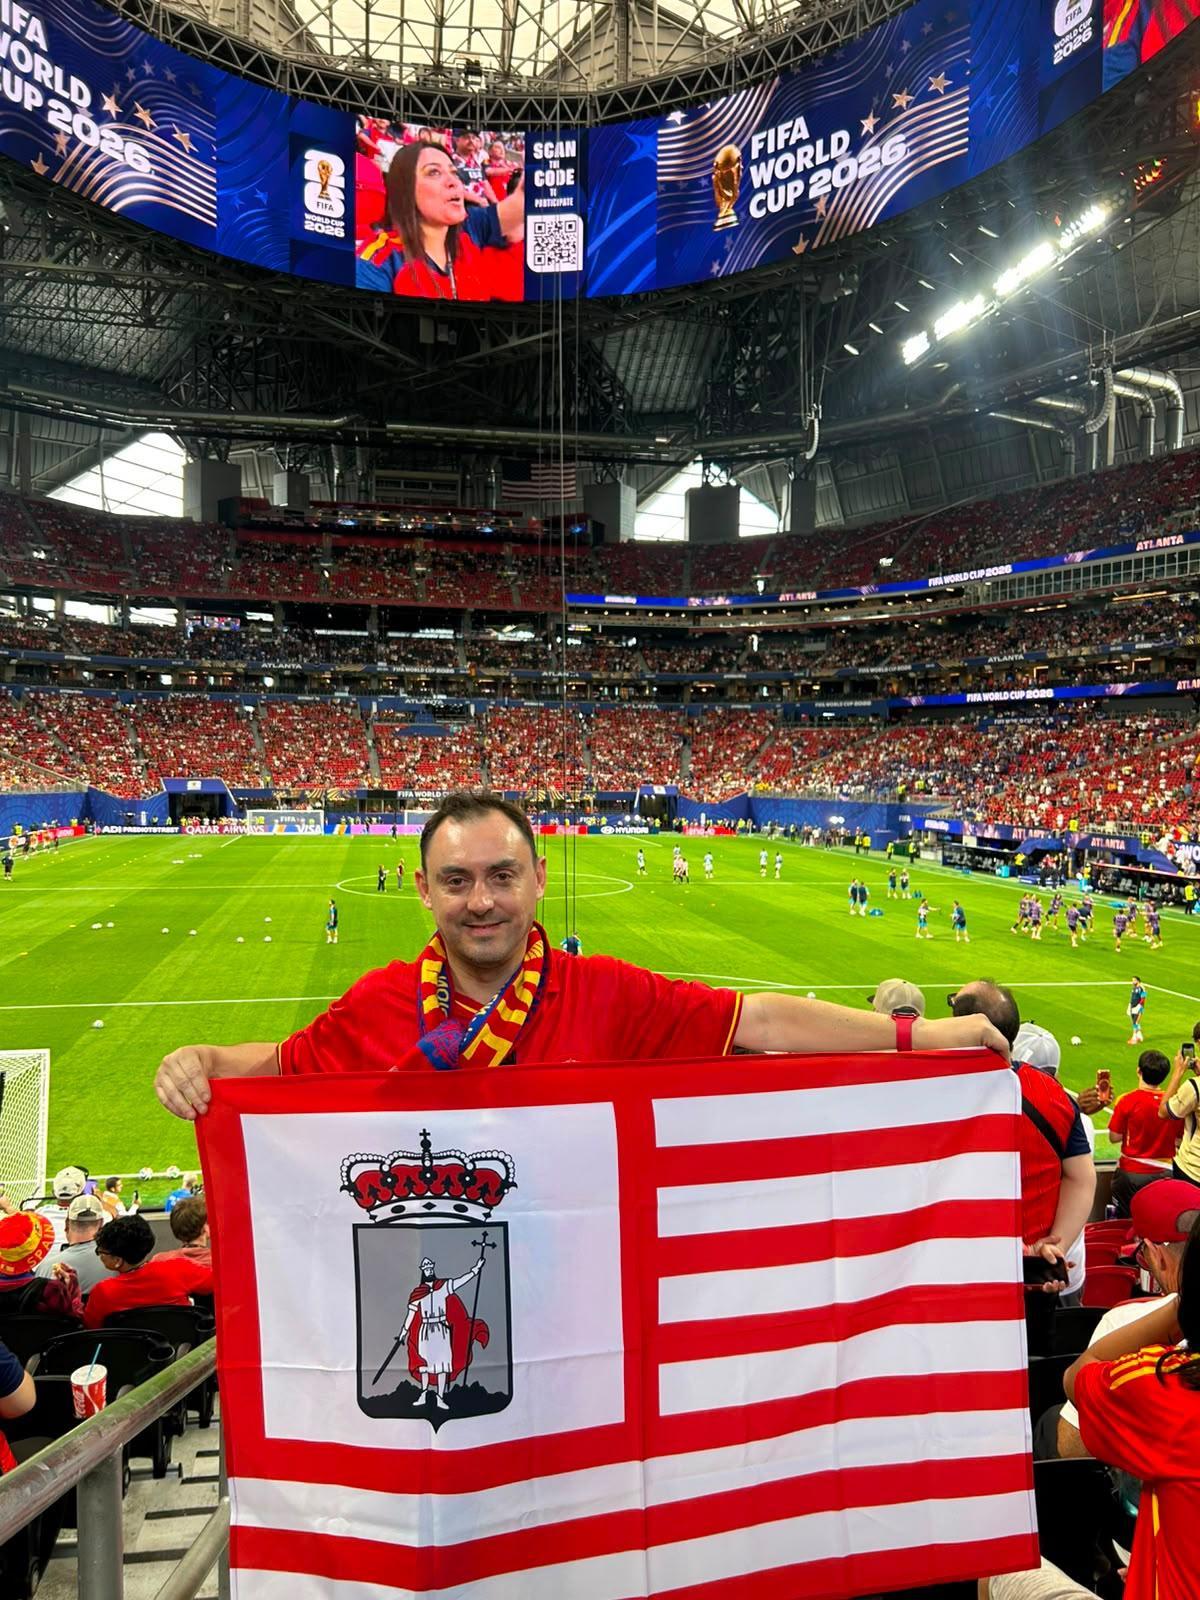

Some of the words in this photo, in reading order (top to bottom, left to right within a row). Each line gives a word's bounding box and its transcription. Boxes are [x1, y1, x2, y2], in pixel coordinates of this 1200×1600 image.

[1065, 6, 1082, 25] FIFA
[1054, 28, 1079, 50] WORLD
[1079, 17, 1092, 32] CUP
[1053, 27, 1092, 65] 2026
[0, 68, 43, 111] UP
[48, 99, 150, 173] 2026
[751, 116, 810, 160] FIFA
[533, 141, 577, 159] SCAN
[750, 130, 850, 189] WORLD
[534, 169, 575, 187] CODE
[749, 179, 804, 219] CUP
[809, 134, 907, 199] 2026
[316, 201, 334, 212] FIFA
[535, 197, 574, 208] PARTICIPATE
[304, 212, 330, 225] WORLD
[331, 219, 345, 227] CUP
[304, 220, 345, 238] 2026
[1136, 534, 1184, 551] ATLANTA
[928, 577, 944, 587] FIFA
[944, 572, 969, 584] WORLD
[969, 569, 985, 580] CUP
[985, 564, 1012, 577] 2026
[779, 591, 817, 602] ATLANTA
[988, 654, 1024, 663] ATLANTA
[966, 692, 982, 703] FIFA
[982, 691, 1009, 702] WORLD
[1009, 690, 1025, 700] CUP
[1025, 688, 1054, 699] 2026
[185, 825, 219, 834] QATAR
[223, 825, 264, 834] AIRWAYS
[296, 825, 322, 833] VISA
[1091, 837, 1125, 850] ATLANTA
[27, 1224, 55, 1268] SPAIN
